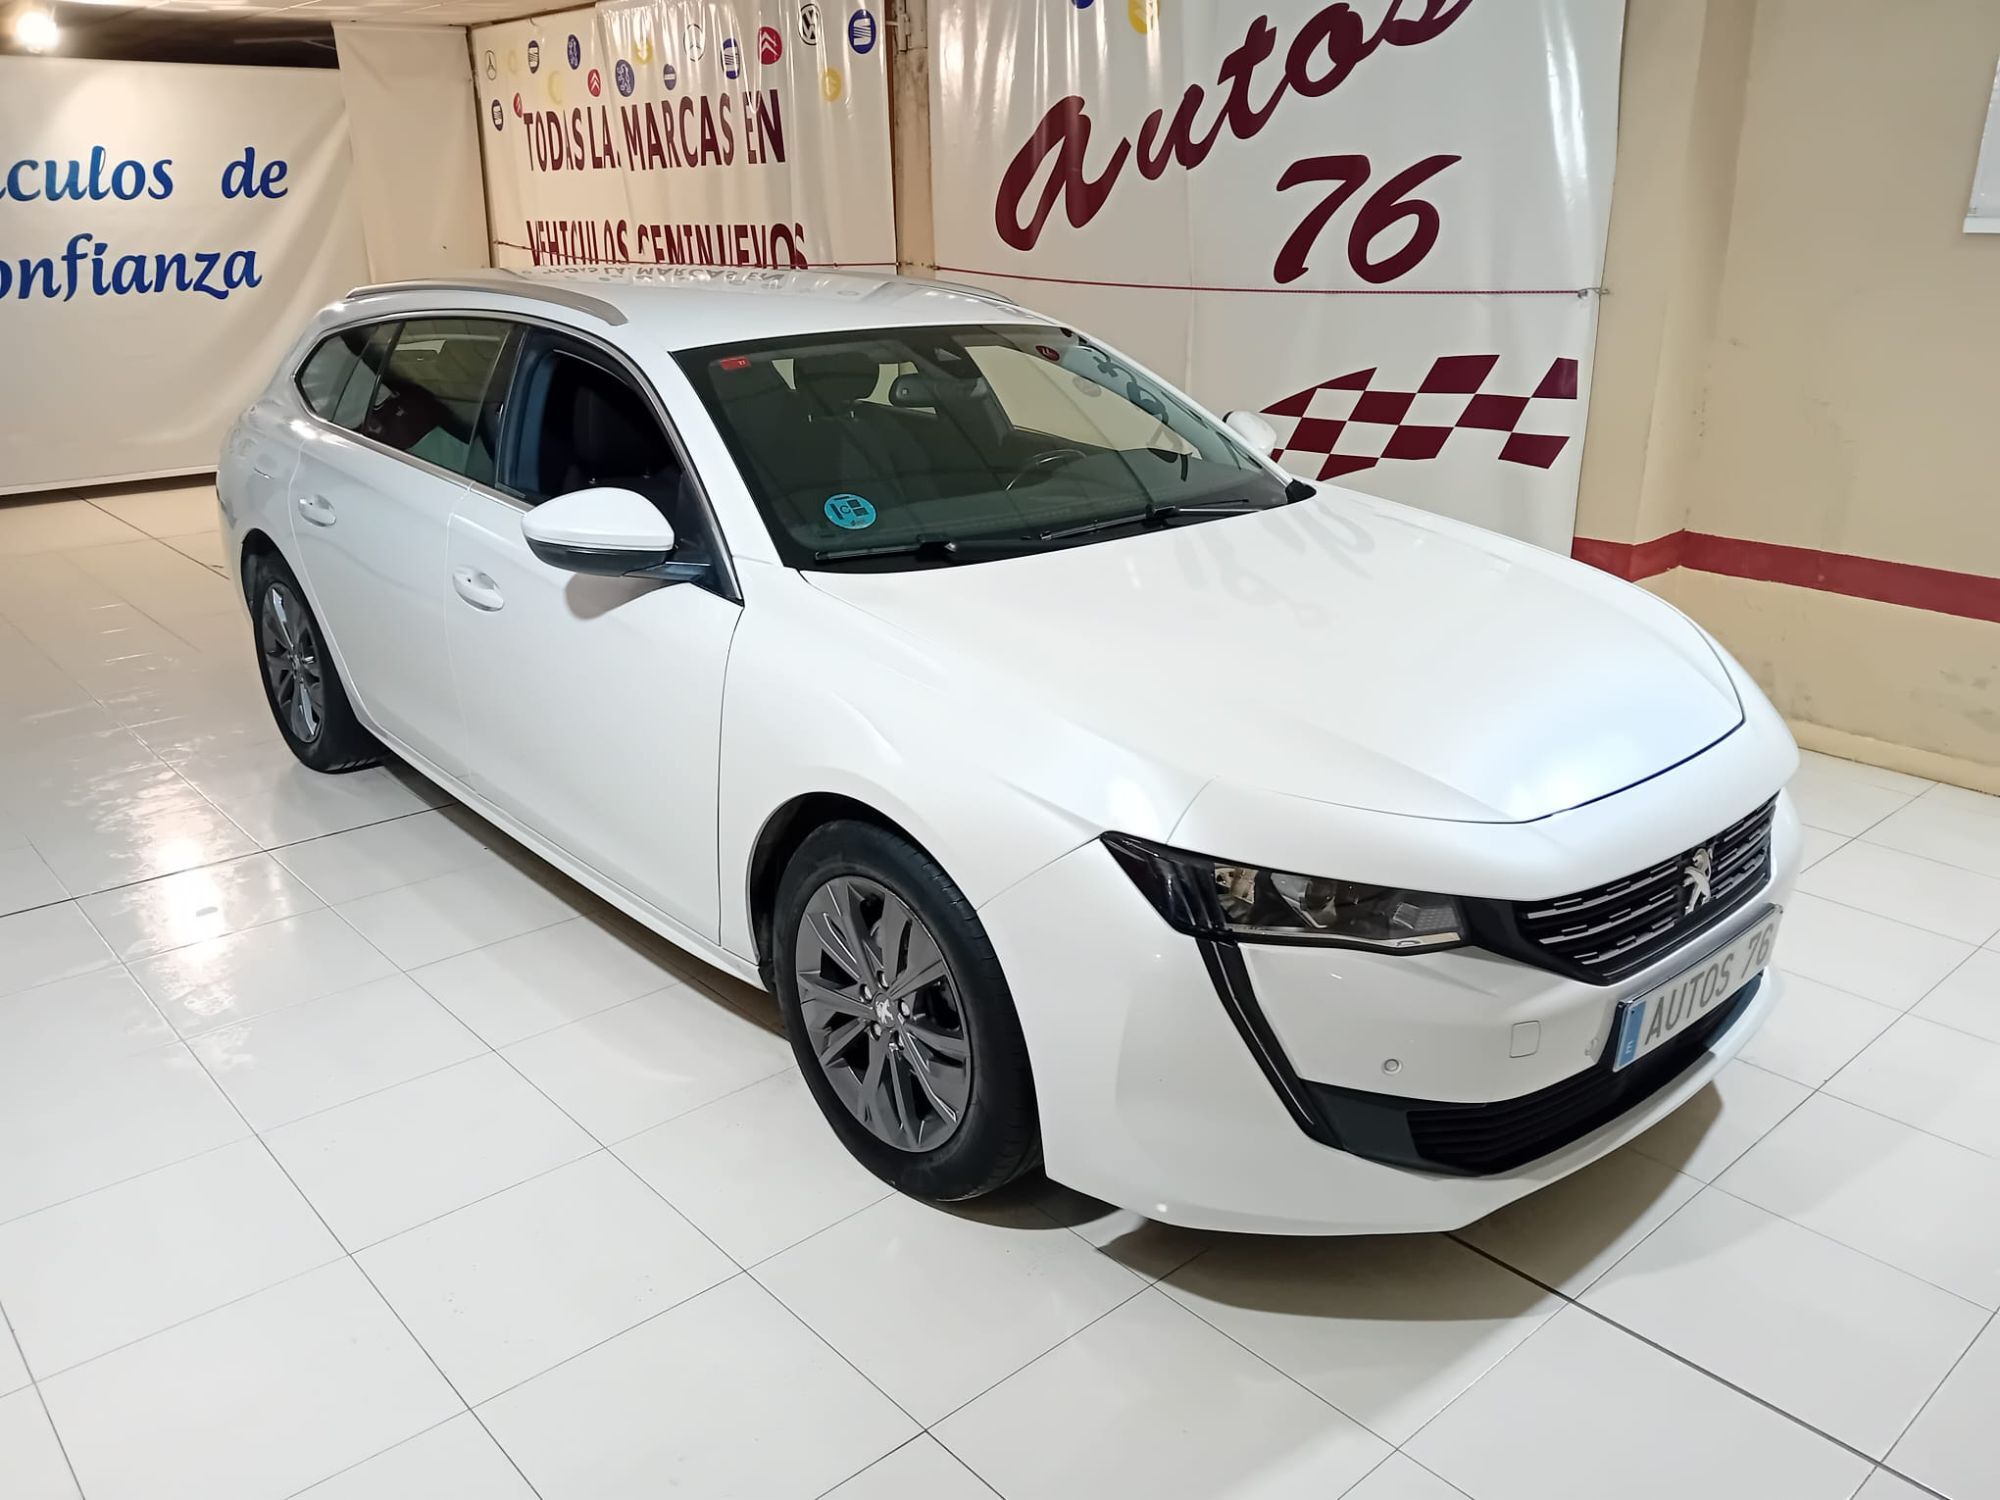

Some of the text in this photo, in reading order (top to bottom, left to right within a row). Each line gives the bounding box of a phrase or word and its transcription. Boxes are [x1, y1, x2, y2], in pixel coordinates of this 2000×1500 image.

[0, 146, 288, 201] culos de
[621, 93, 734, 171] MARCAS
[743, 89, 785, 164] EN
[1272, 154, 1461, 284] 76
[1644, 922, 1774, 1046] AUTOS 76
